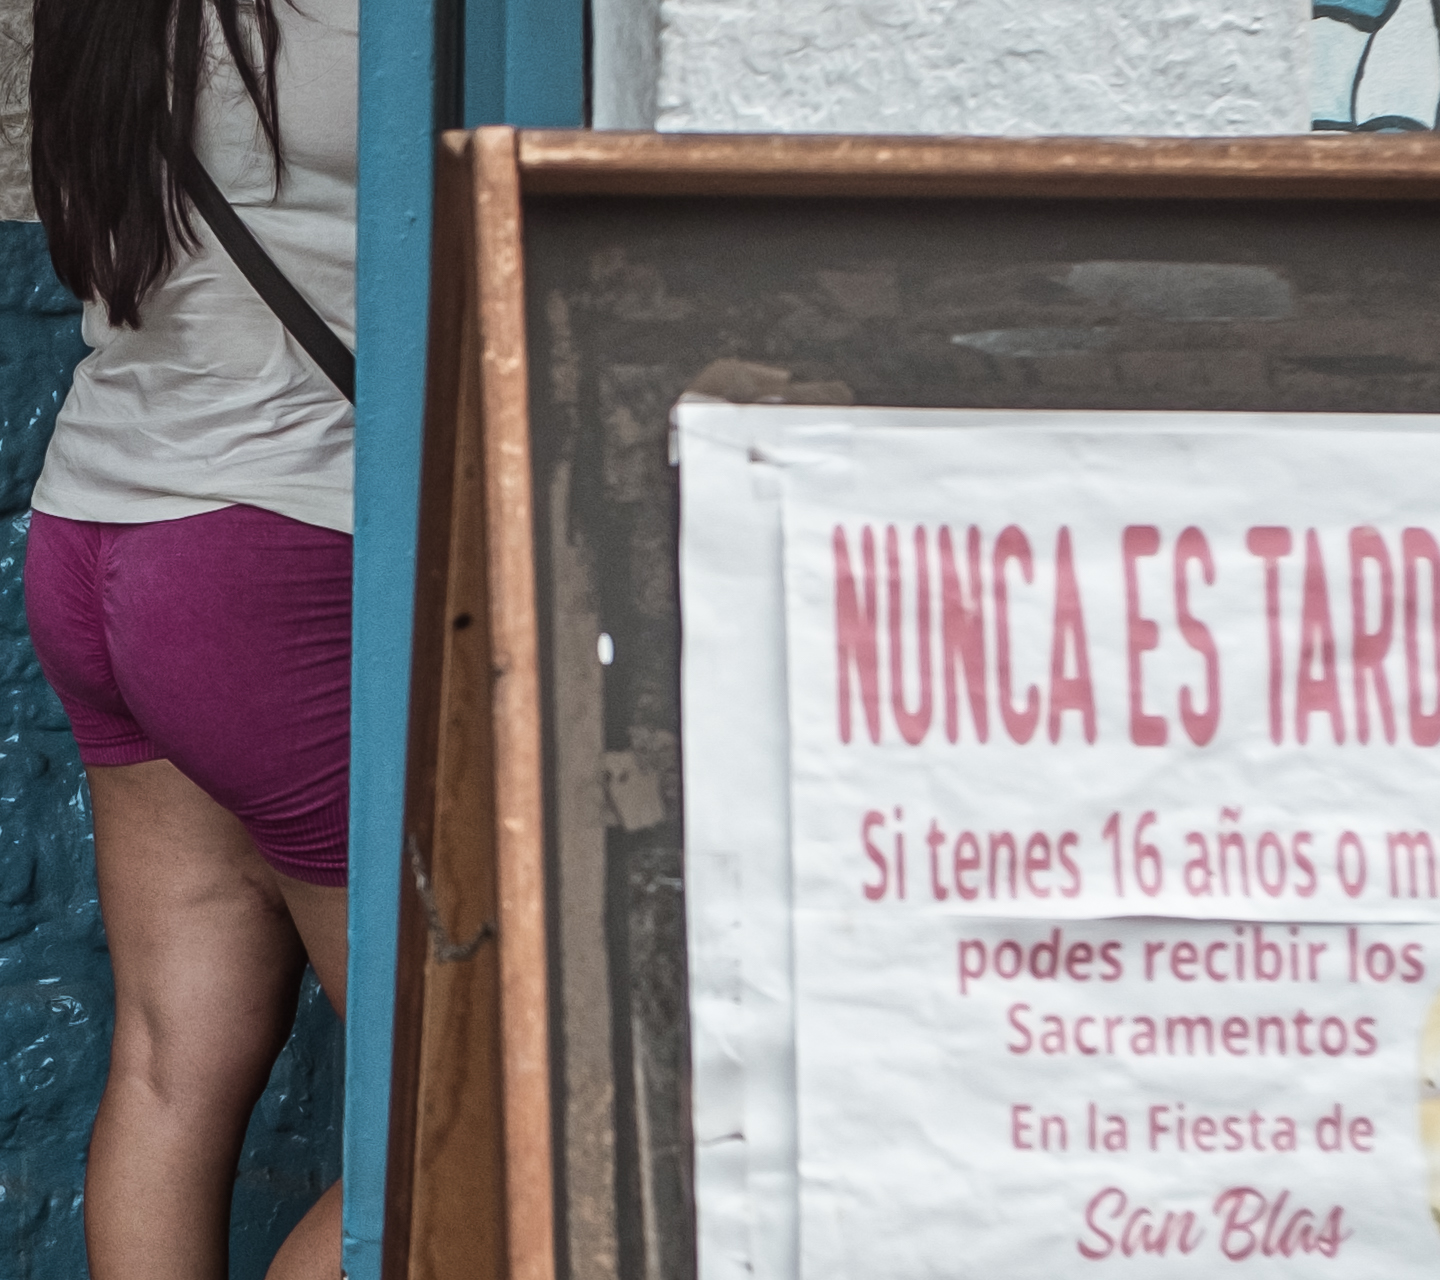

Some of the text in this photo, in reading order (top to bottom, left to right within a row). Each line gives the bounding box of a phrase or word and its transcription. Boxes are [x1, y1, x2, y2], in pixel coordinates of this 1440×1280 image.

[831, 521, 1098, 747] NUNCA
[1120, 523, 1220, 747] ES
[860, 806, 906, 902] Si
[927, 819, 1082, 900] tenes
[1102, 808, 1161, 898] 16
[1184, 805, 1319, 900] años
[1337, 828, 1368, 900] o
[956, 923, 1425, 995] podes recibir los
[1005, 1002, 1380, 1060] Sacramentos
[1011, 1100, 1376, 1153] En la Fiesta de
[1076, 1186, 1351, 1266] San Blas
